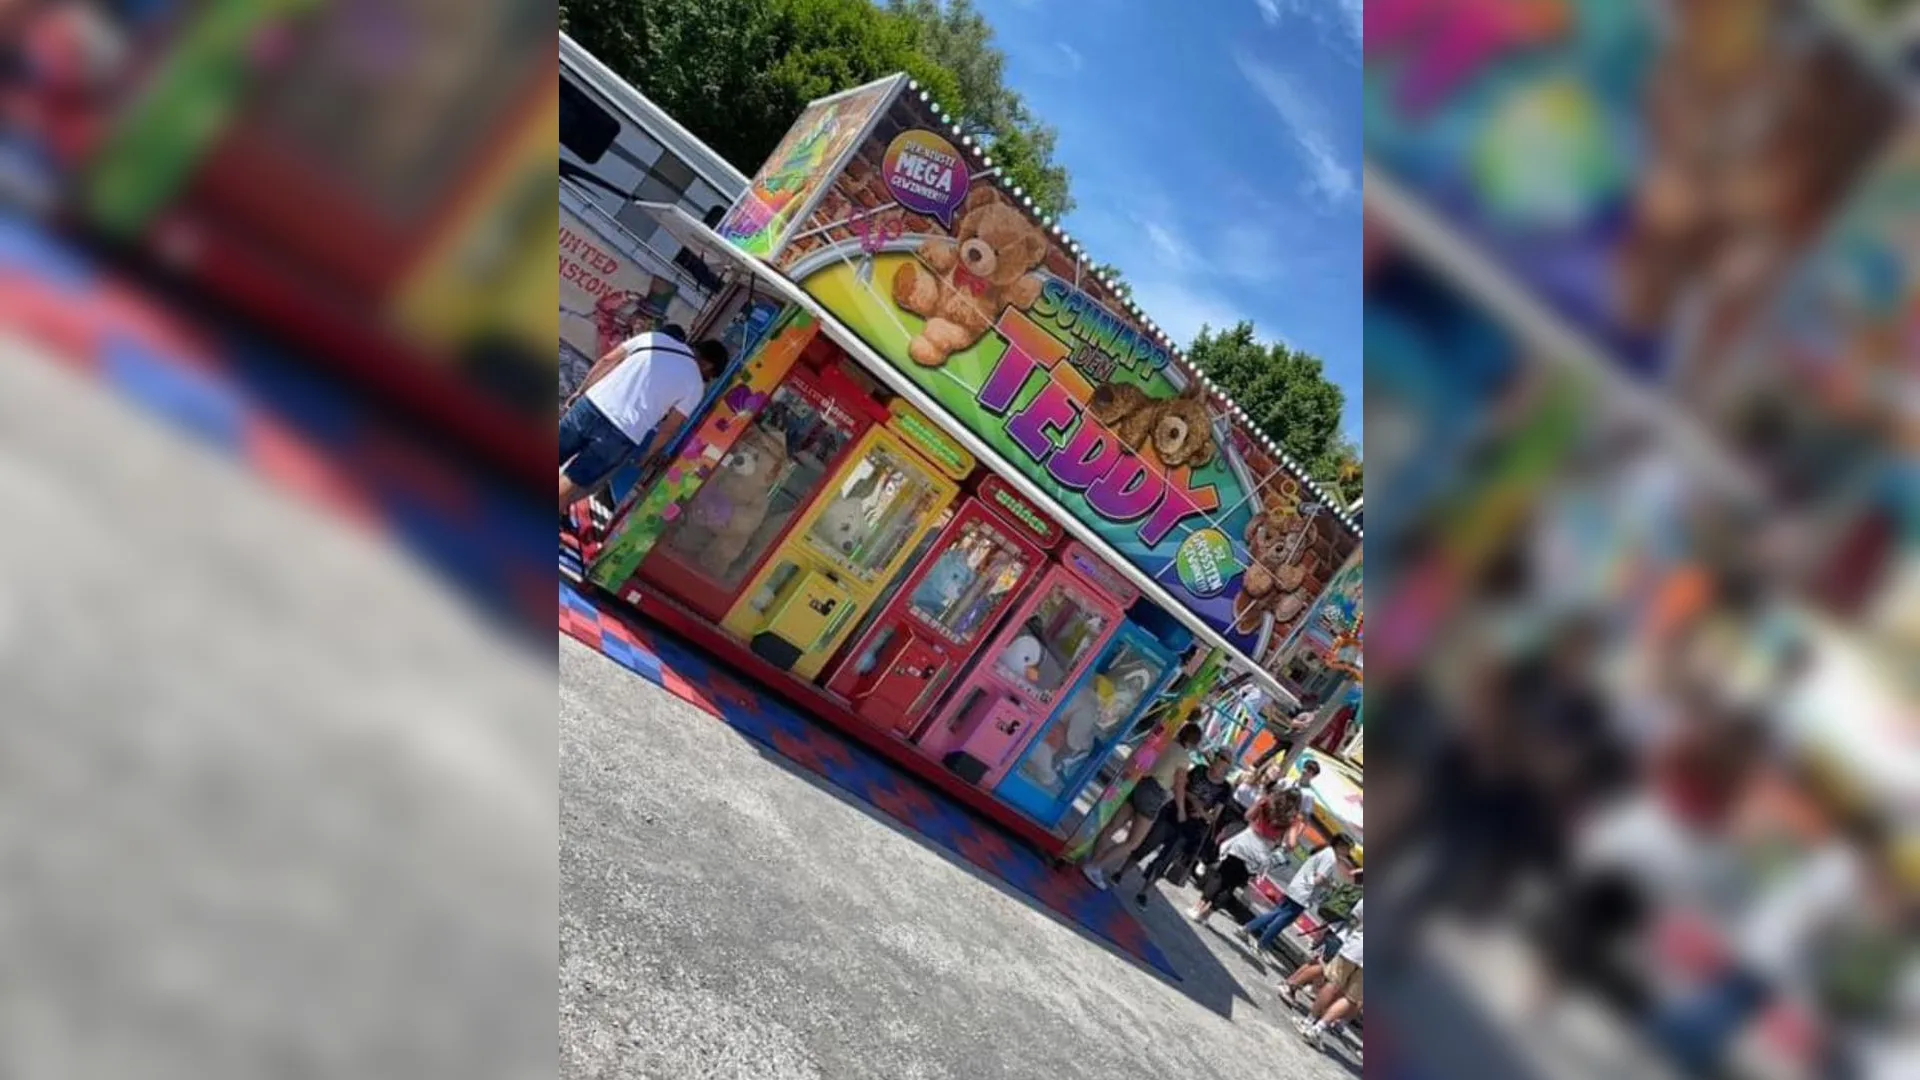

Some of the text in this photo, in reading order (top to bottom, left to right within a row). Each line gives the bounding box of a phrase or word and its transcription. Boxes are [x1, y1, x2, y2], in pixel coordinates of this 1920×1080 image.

[894, 150, 952, 192] MEGA
[1030, 280, 1170, 379] SCHNAPP
[1073, 343, 1118, 381] DEN
[978, 305, 1220, 547] TEDDY
